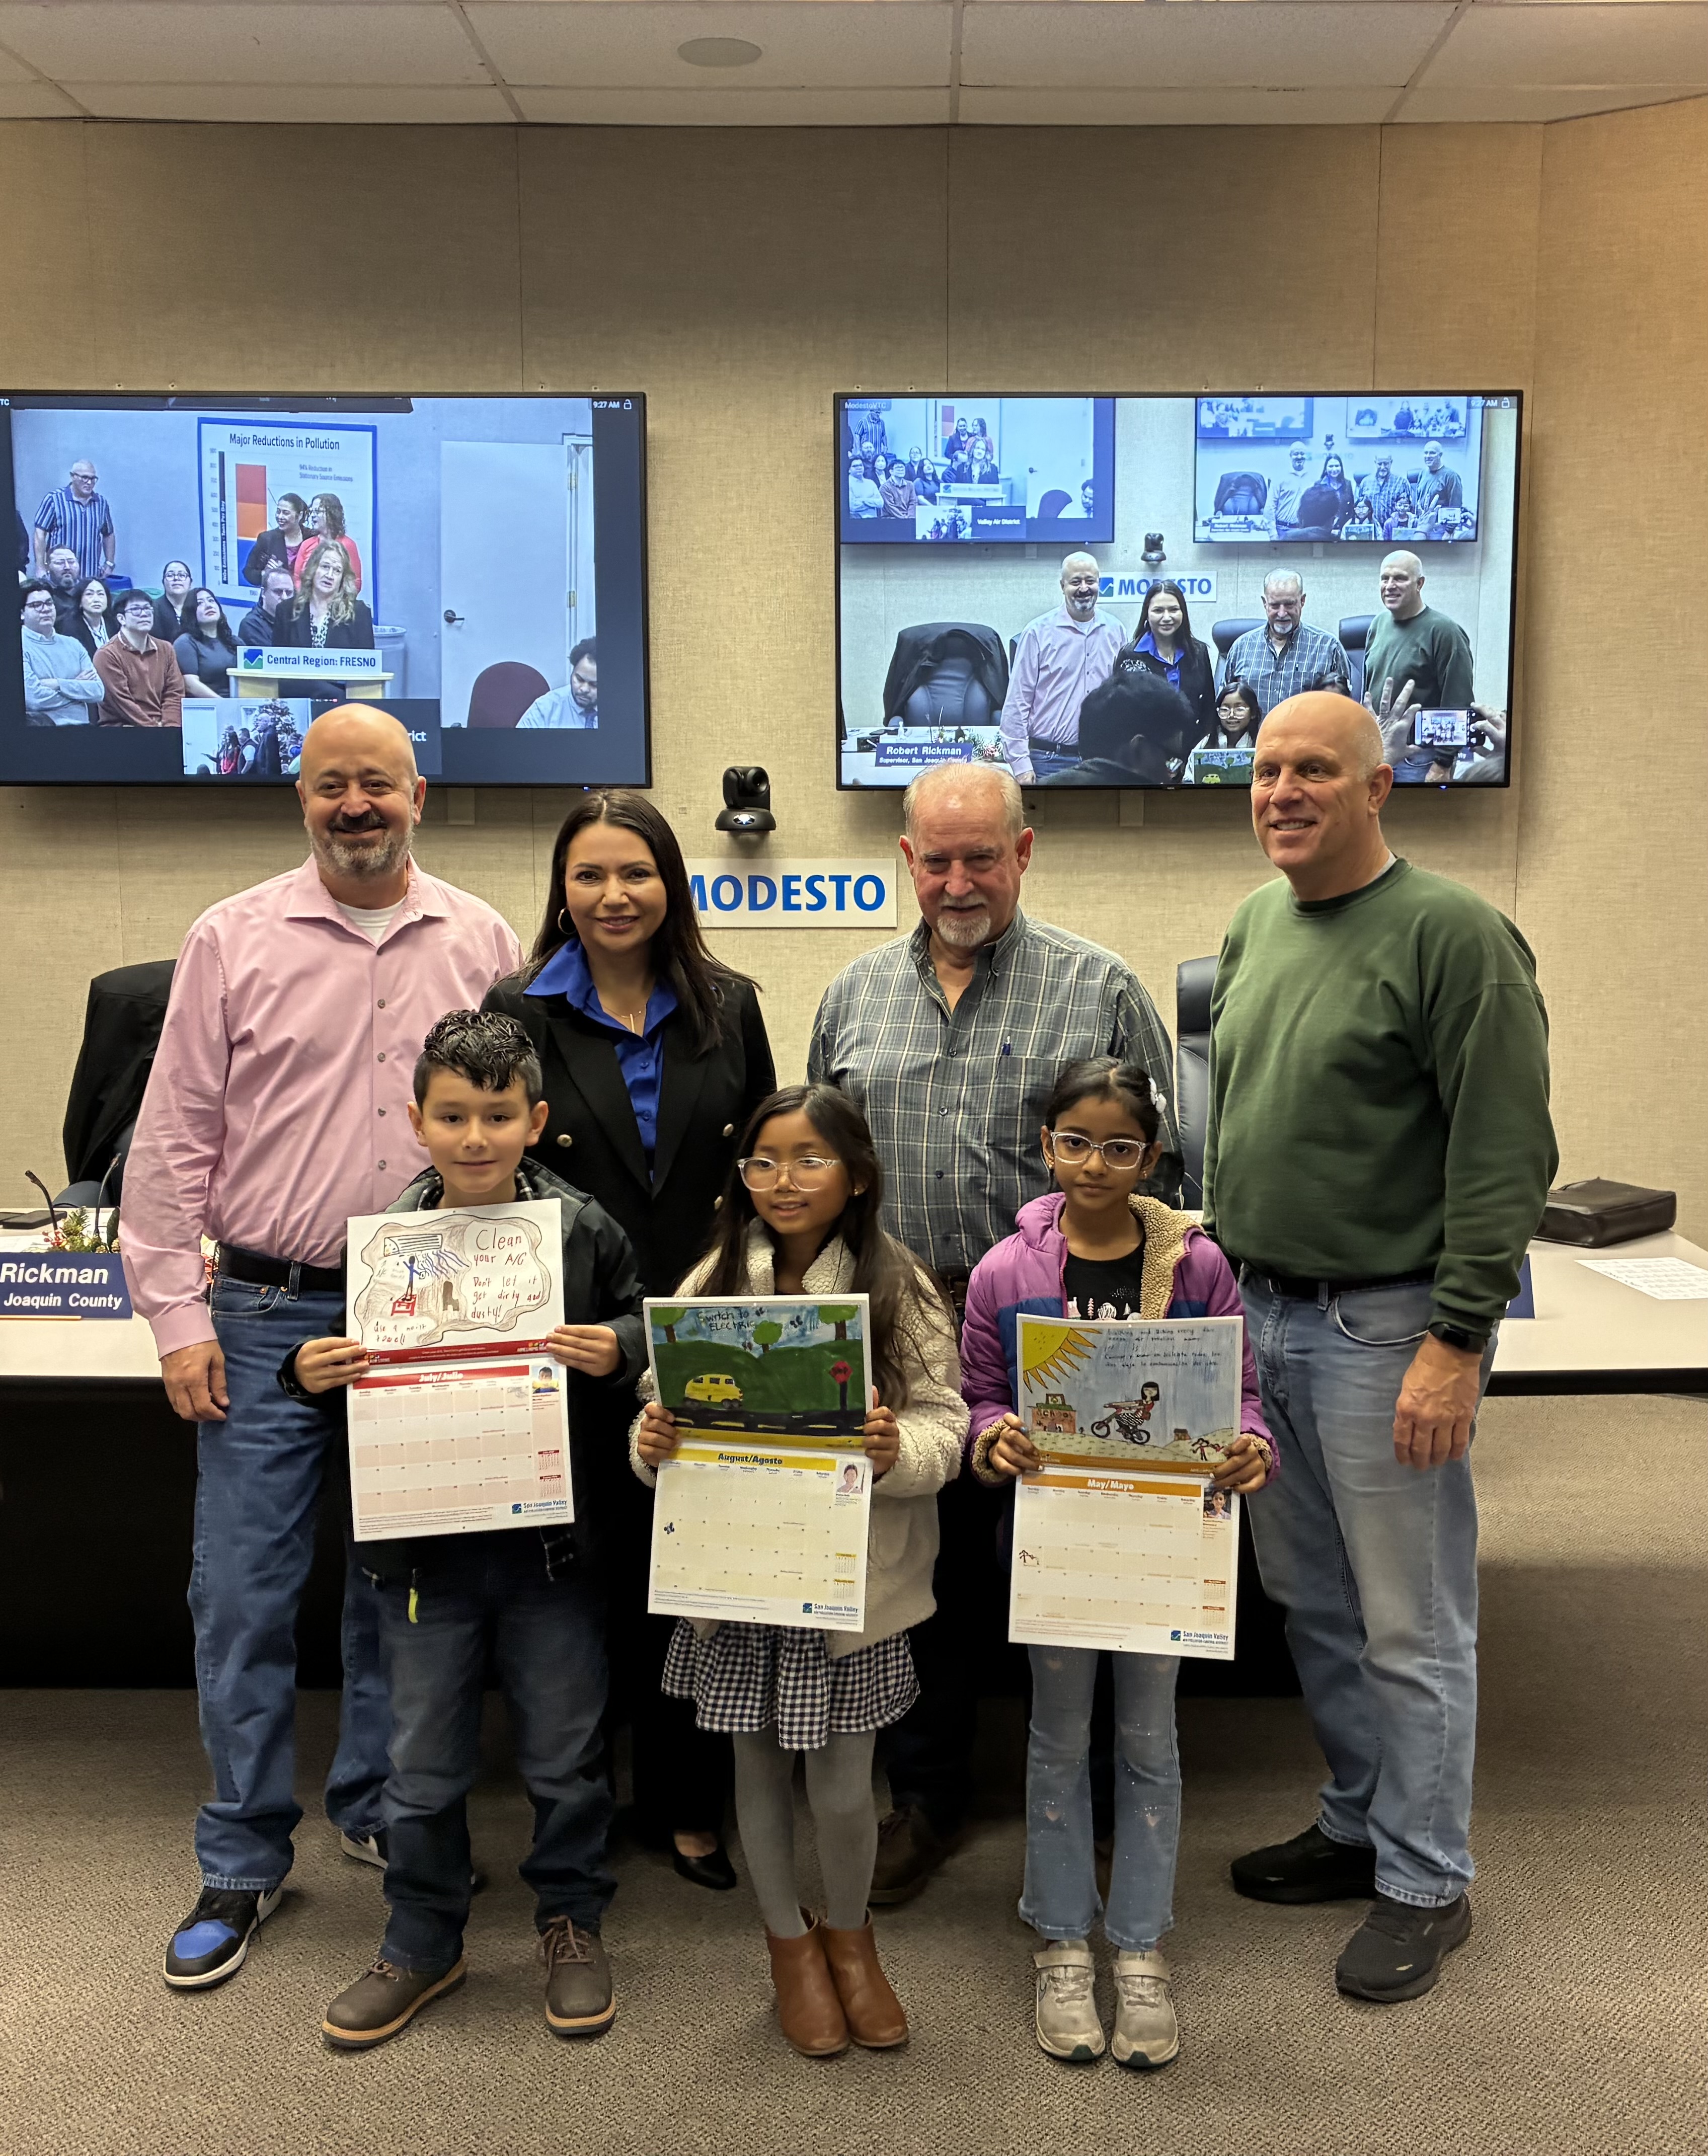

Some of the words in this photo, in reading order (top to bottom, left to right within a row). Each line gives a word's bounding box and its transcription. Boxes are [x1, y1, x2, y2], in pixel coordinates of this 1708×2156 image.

[229, 433, 251, 447] Major
[252, 435, 294, 447] Reductions
[296, 436, 303, 448] in
[305, 437, 340, 450] Pollution
[1118, 578, 1211, 595] MOSTO
[267, 655, 300, 665] Central
[303, 656, 338, 668] Region:
[340, 657, 376, 667] FRESNO
[886, 746, 918, 754] Robert
[922, 746, 962, 755] Rickman
[689, 874, 885, 911] MODESTO
[476, 1228, 521, 1250] Clean
[474, 1254, 496, 1266] your
[505, 1252, 526, 1266] A/C
[0, 1263, 108, 1284] Rickman
[474, 1277, 491, 1287] Don't
[503, 1275, 517, 1287] let
[529, 1275, 537, 1284] it
[4, 1292, 61, 1309] Joaquin
[68, 1293, 123, 1310] County
[473, 1291, 487, 1305] get
[498, 1289, 519, 1308] dirty
[472, 1304, 502, 1323] dusty!
[419, 1371, 463, 1382] July/Julio
[718, 1453, 783, 1466] August/Agosto
[1088, 1479, 1134, 1492] May/Mayo
